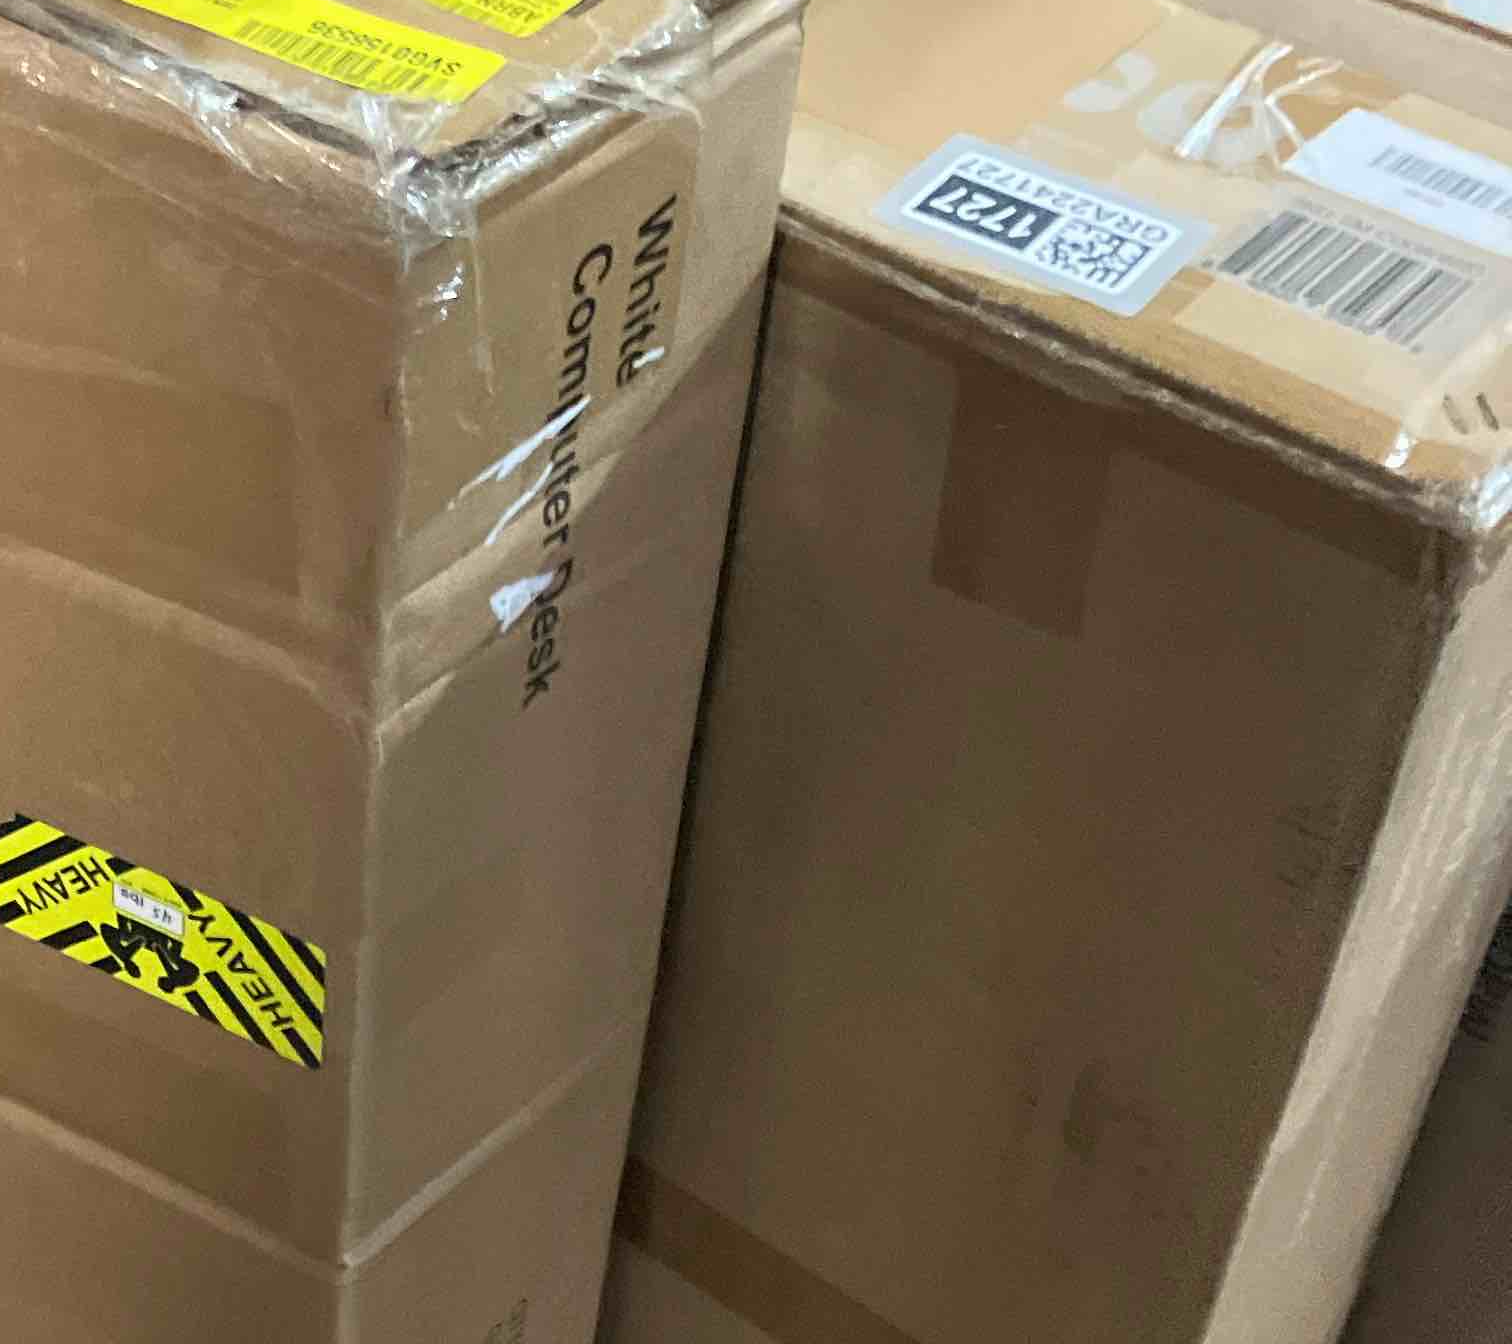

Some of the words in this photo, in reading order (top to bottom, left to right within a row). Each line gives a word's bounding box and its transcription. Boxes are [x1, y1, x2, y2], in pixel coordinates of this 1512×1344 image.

[928, 186, 1037, 240] 1727
[615, 193, 677, 388] White
[521, 557, 573, 709] Desk
[17, 856, 110, 915] HEAVY
[187, 912, 294, 1028] HEAVY
